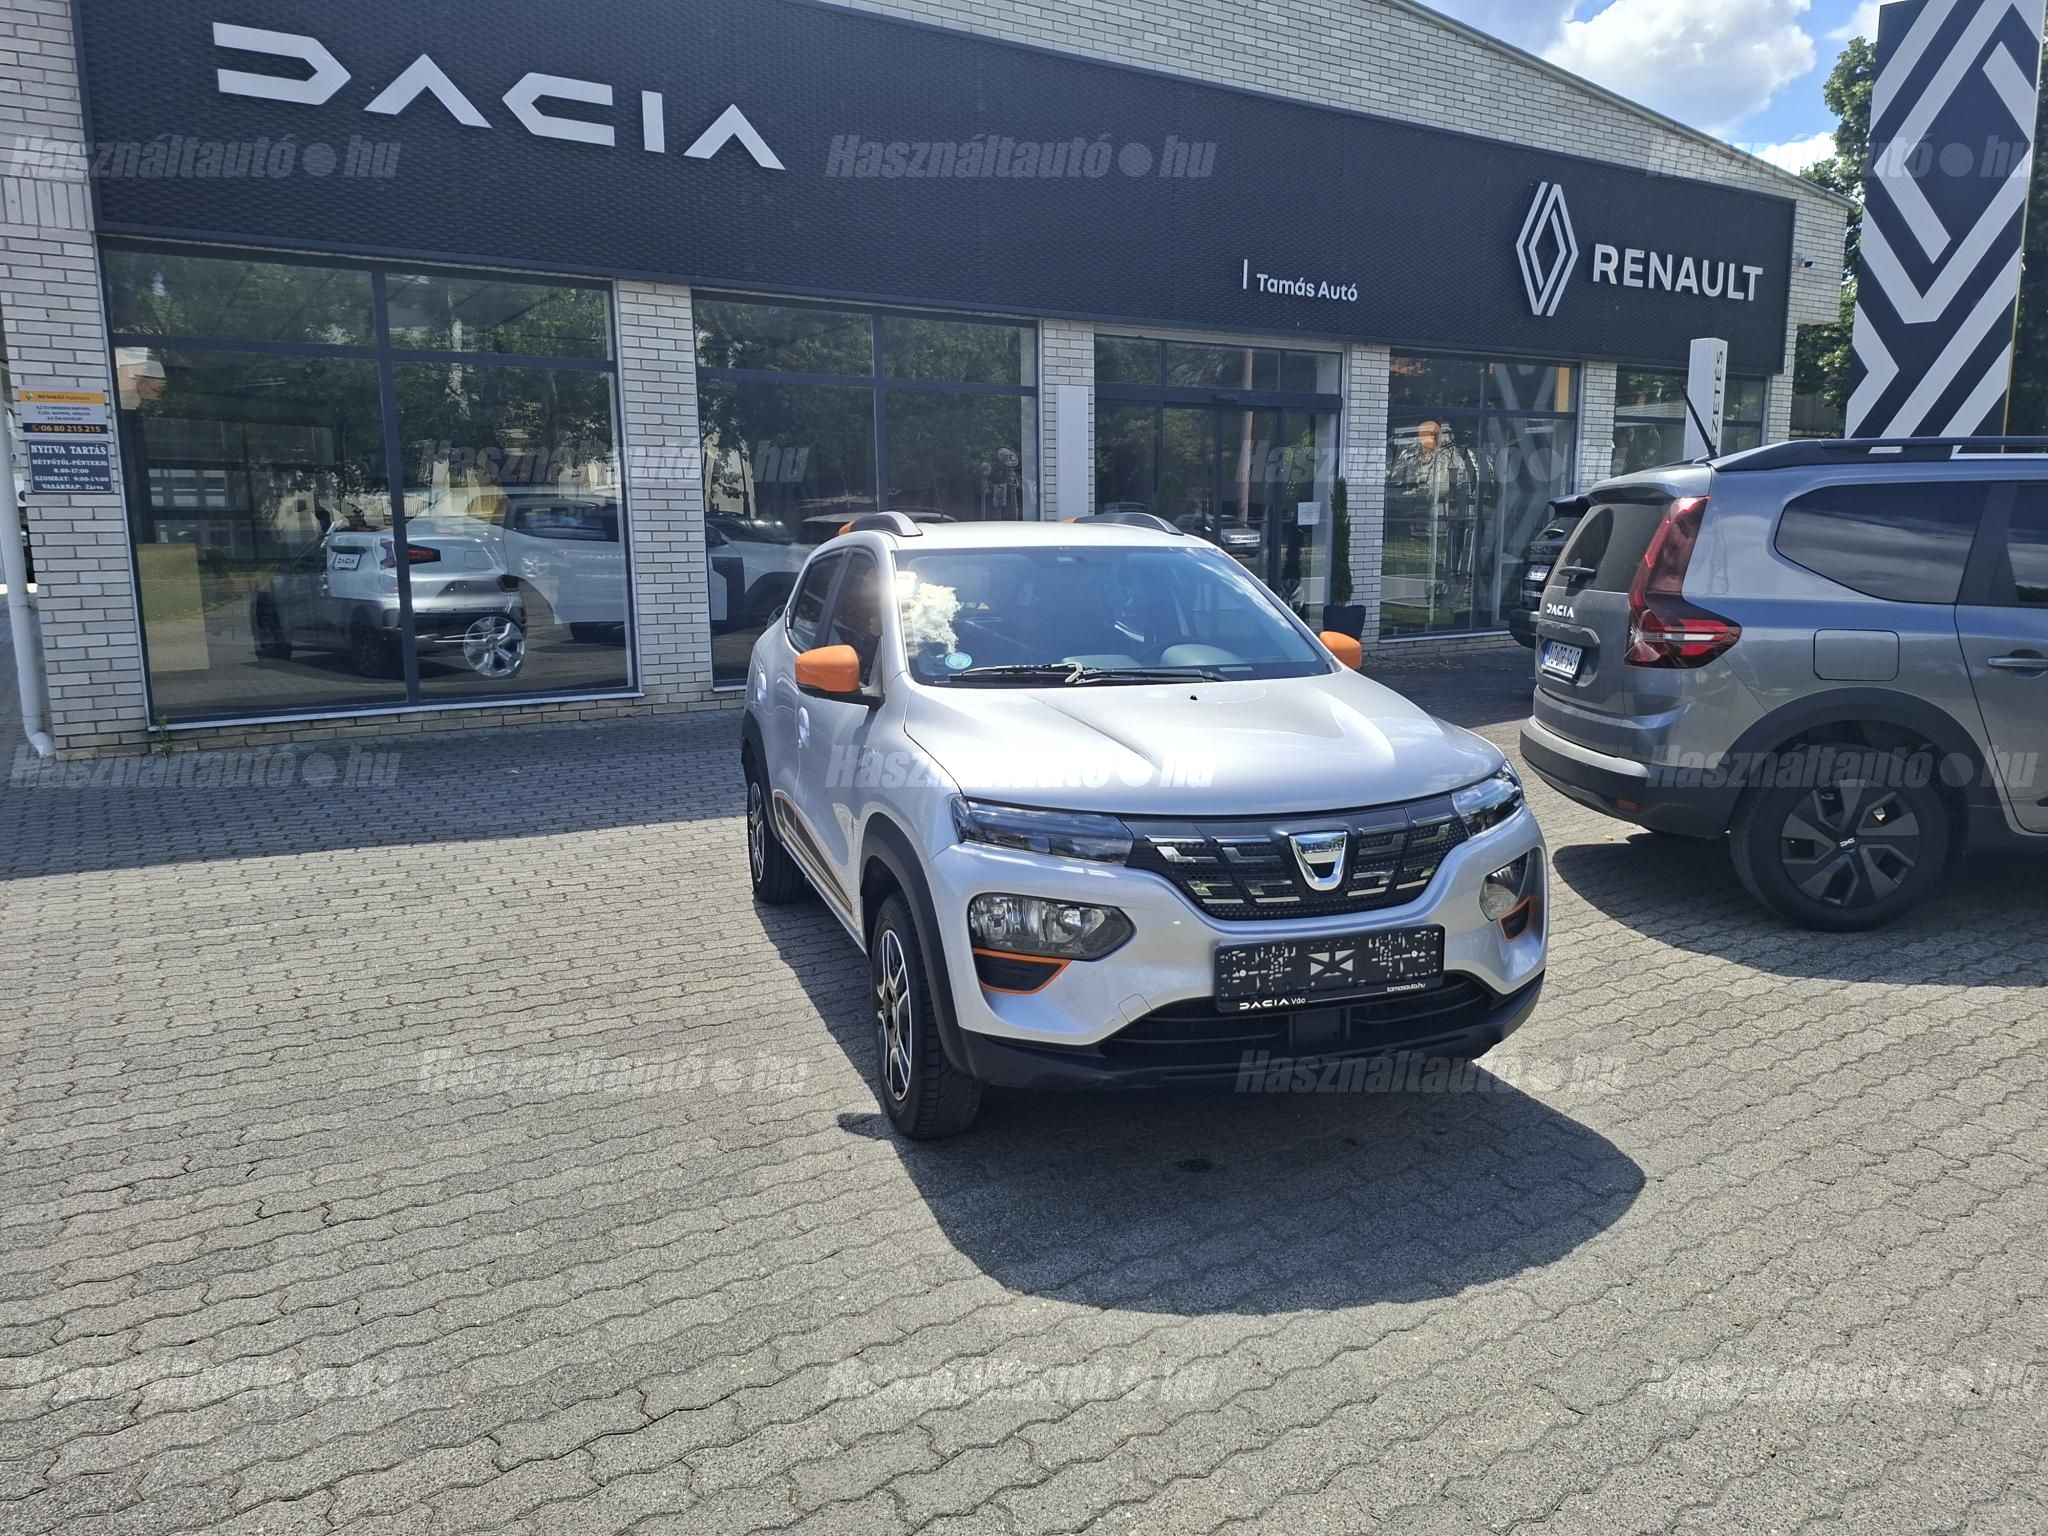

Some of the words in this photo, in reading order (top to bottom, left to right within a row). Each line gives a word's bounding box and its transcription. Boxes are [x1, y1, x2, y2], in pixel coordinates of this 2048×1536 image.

[212, 21, 787, 171] DACIA
[1592, 243, 1764, 302] RENAULT
[1256, 273, 1315, 297] Tamás
[1317, 283, 1358, 302] Autó
[40, 424, 52, 432] 06
[66, 425, 84, 433] 215
[85, 425, 101, 433] 215
[31, 445, 66, 454] NYITVA
[69, 444, 107, 455] TARTÁS
[1546, 602, 1574, 618] DACIA
[1239, 998, 1289, 1010] DACIA
